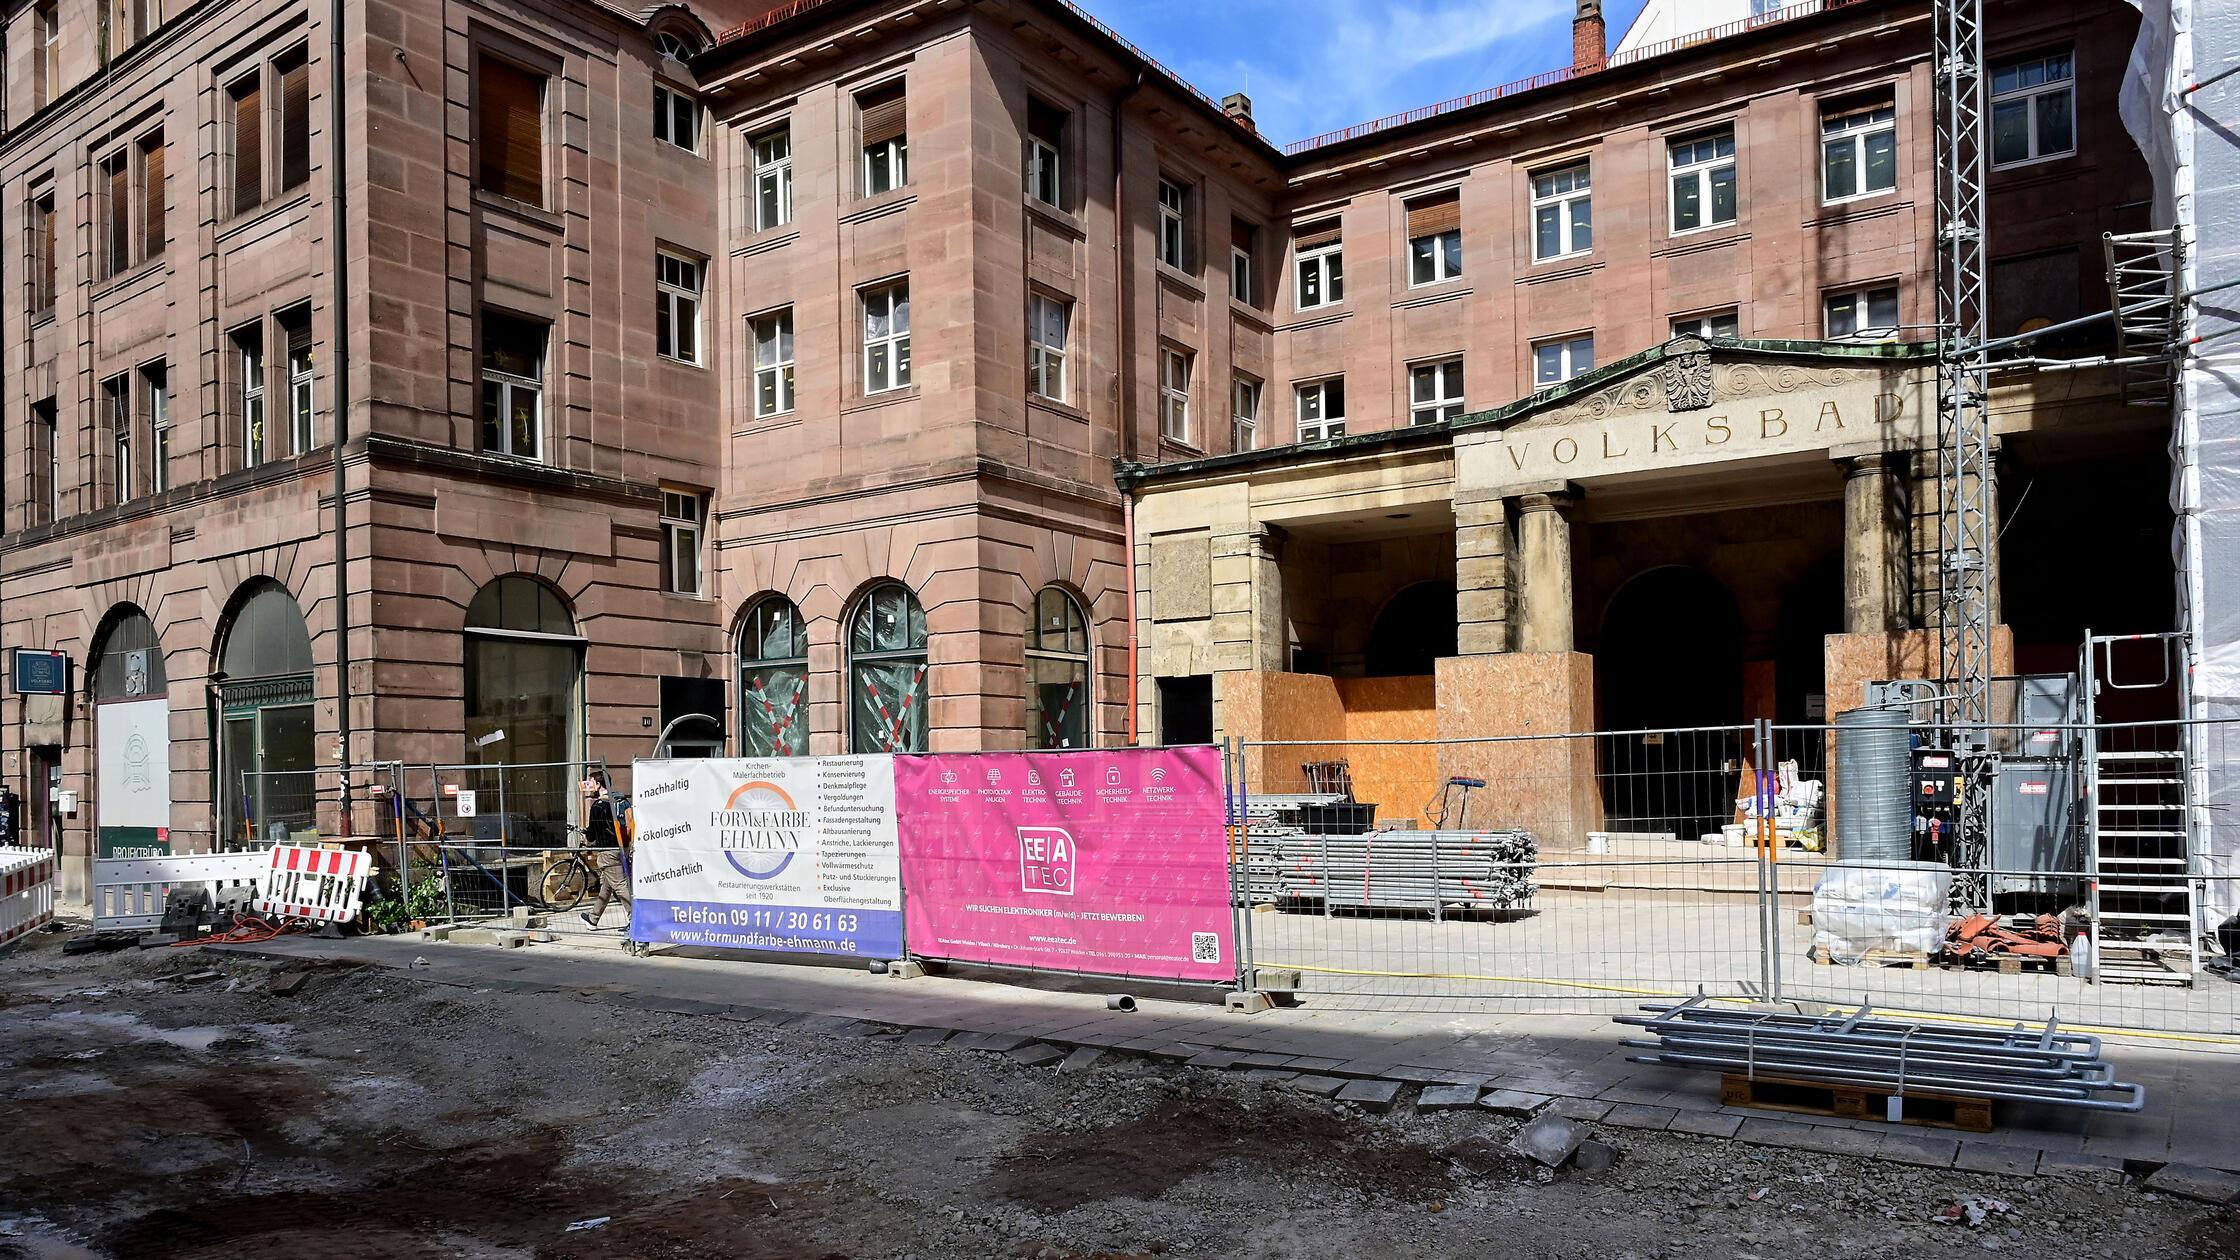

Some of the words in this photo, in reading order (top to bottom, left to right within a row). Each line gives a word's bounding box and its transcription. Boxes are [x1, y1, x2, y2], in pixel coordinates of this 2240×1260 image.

[1505, 391, 1905, 471] VOLKSBAD
[745, 762, 771, 770] Kirchen-
[733, 771, 786, 779] Malerfachbetrieb
[823, 771, 866, 779] Konservierung
[644, 778, 689, 798] nachhaltig
[823, 782, 867, 790] Denkmalpflege
[1055, 789, 1083, 797] GEBÄUDE-
[1095, 788, 1132, 796] SICHERHEITS-
[823, 794, 864, 802] Vergoldungen
[823, 805, 884, 813] Befunduntersuchung
[711, 811, 811, 827] FORM&FARBE
[823, 816, 881, 825] Fassadengestaltung
[643, 820, 692, 841] ökologisch
[823, 828, 871, 836] Altbausanierung
[720, 830, 801, 849] EHMANN
[822, 839, 851, 847] Anstriche,
[853, 839, 894, 848] Lackierungen
[822, 851, 867, 859] Tapezierungen
[822, 862, 874, 870] Vollwärmeschutz
[644, 862, 703, 884] wirtschaftlich
[1026, 865, 1068, 887] TEC
[840, 873, 852, 881] und
[853, 874, 896, 883] Stuckierungen
[718, 881, 801, 892] Restaurierungswerkstätten
[823, 884, 851, 892] Exclusive
[759, 893, 774, 901] 1920
[823, 895, 892, 907] Oberflächengestaltung
[965, 904, 978, 912] WIR
[979, 905, 1003, 914] SUCHEN
[1004, 906, 1053, 917] ELEKTRONIKER
[1080, 911, 1100, 921] JETZT
[1101, 913, 1145, 922] BEWERBEN!
[671, 905, 727, 925] Telefon
[731, 909, 749, 926] 09
[754, 911, 771, 927] 11
[776, 911, 784, 928] /
[788, 912, 808, 930] 30
[813, 913, 831, 931] 61
[838, 914, 857, 932] 63
[670, 930, 856, 952] www.formundfarbe-ehmann.de
[1029, 935, 1077, 945] www.eeatec.de
